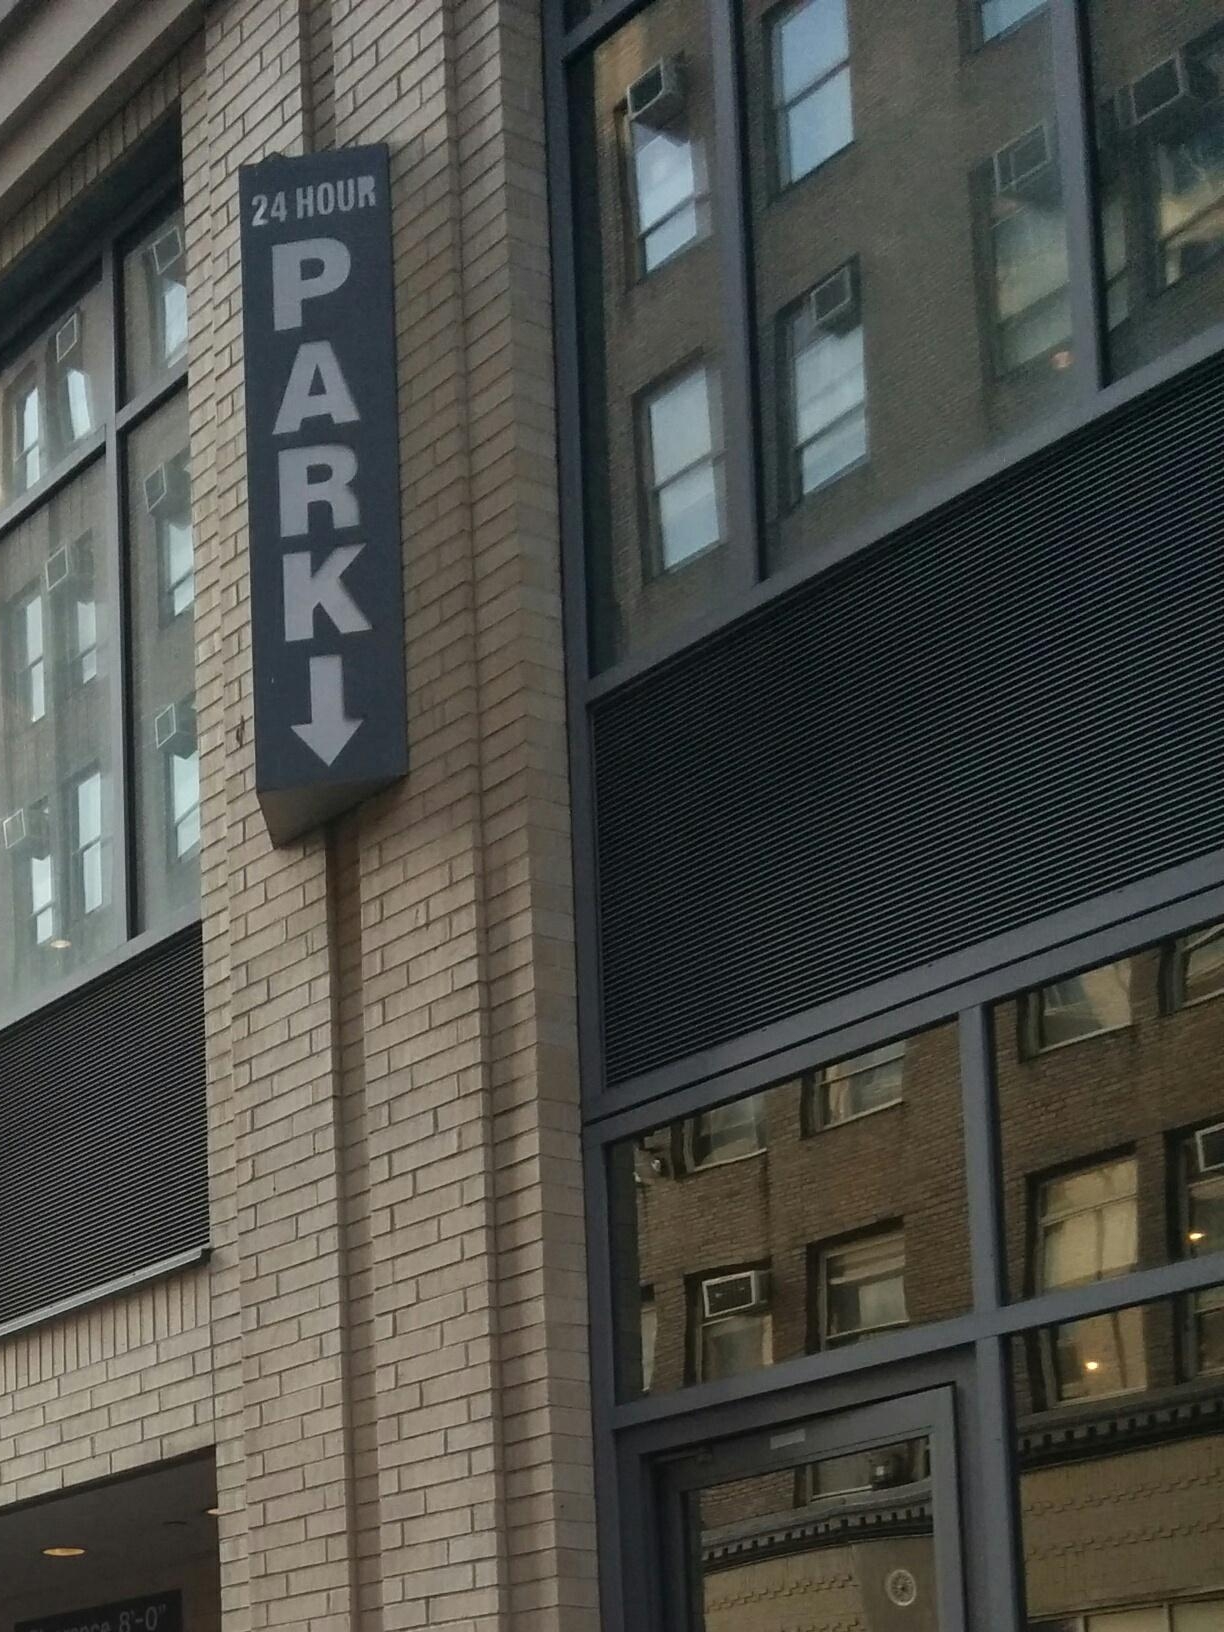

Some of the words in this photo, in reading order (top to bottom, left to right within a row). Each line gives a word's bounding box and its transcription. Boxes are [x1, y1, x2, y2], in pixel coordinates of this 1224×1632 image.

[251, 190, 288, 227] 24
[295, 175, 377, 219] HOUR
[272, 237, 374, 643] PARK
